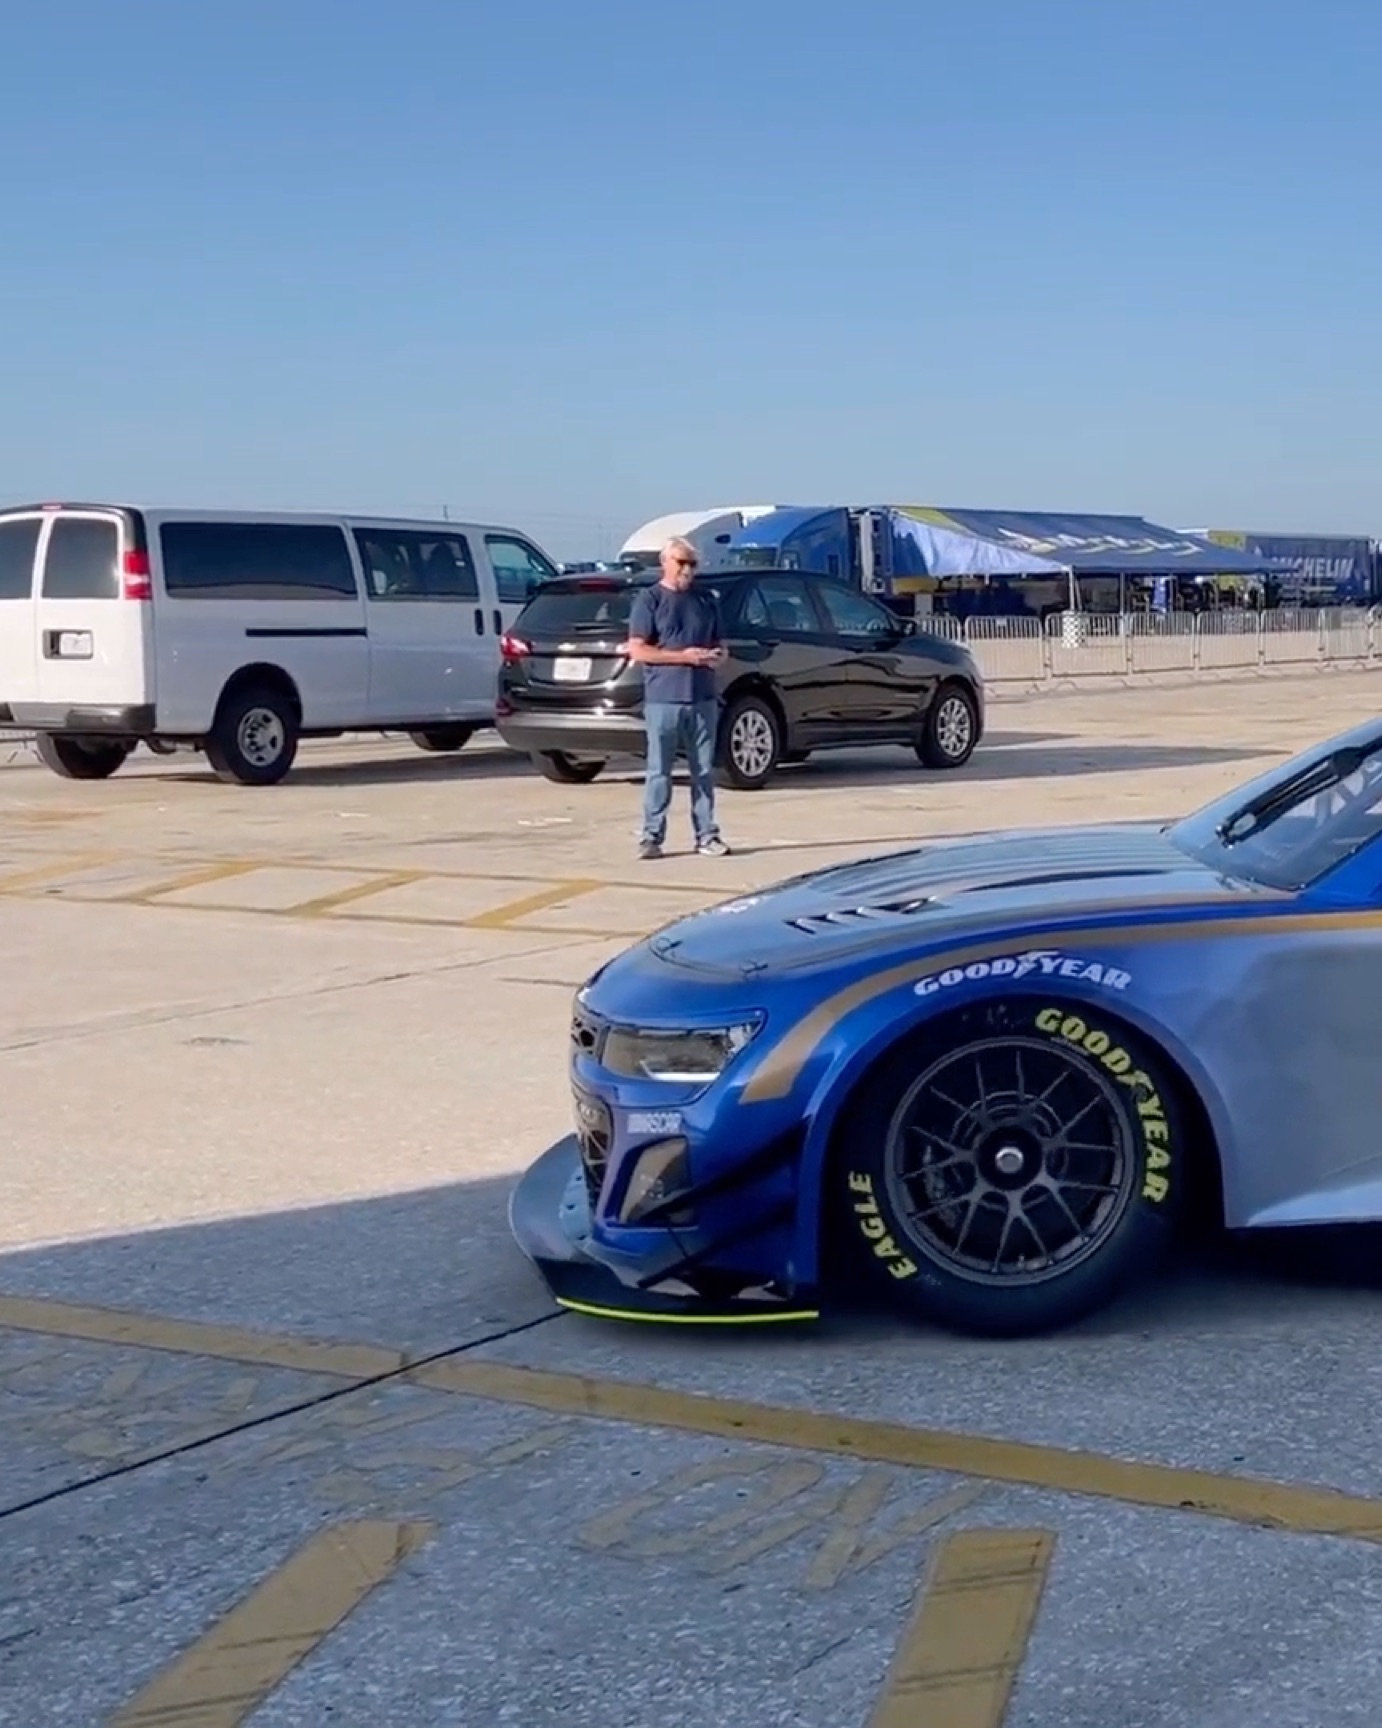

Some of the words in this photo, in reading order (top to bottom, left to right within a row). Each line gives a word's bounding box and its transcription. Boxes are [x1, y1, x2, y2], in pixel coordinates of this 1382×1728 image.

[914, 951, 1132, 996] GOODYEAR
[1035, 1008, 1172, 1203] GOODYEAR
[848, 1170, 918, 1279] EAGLE
